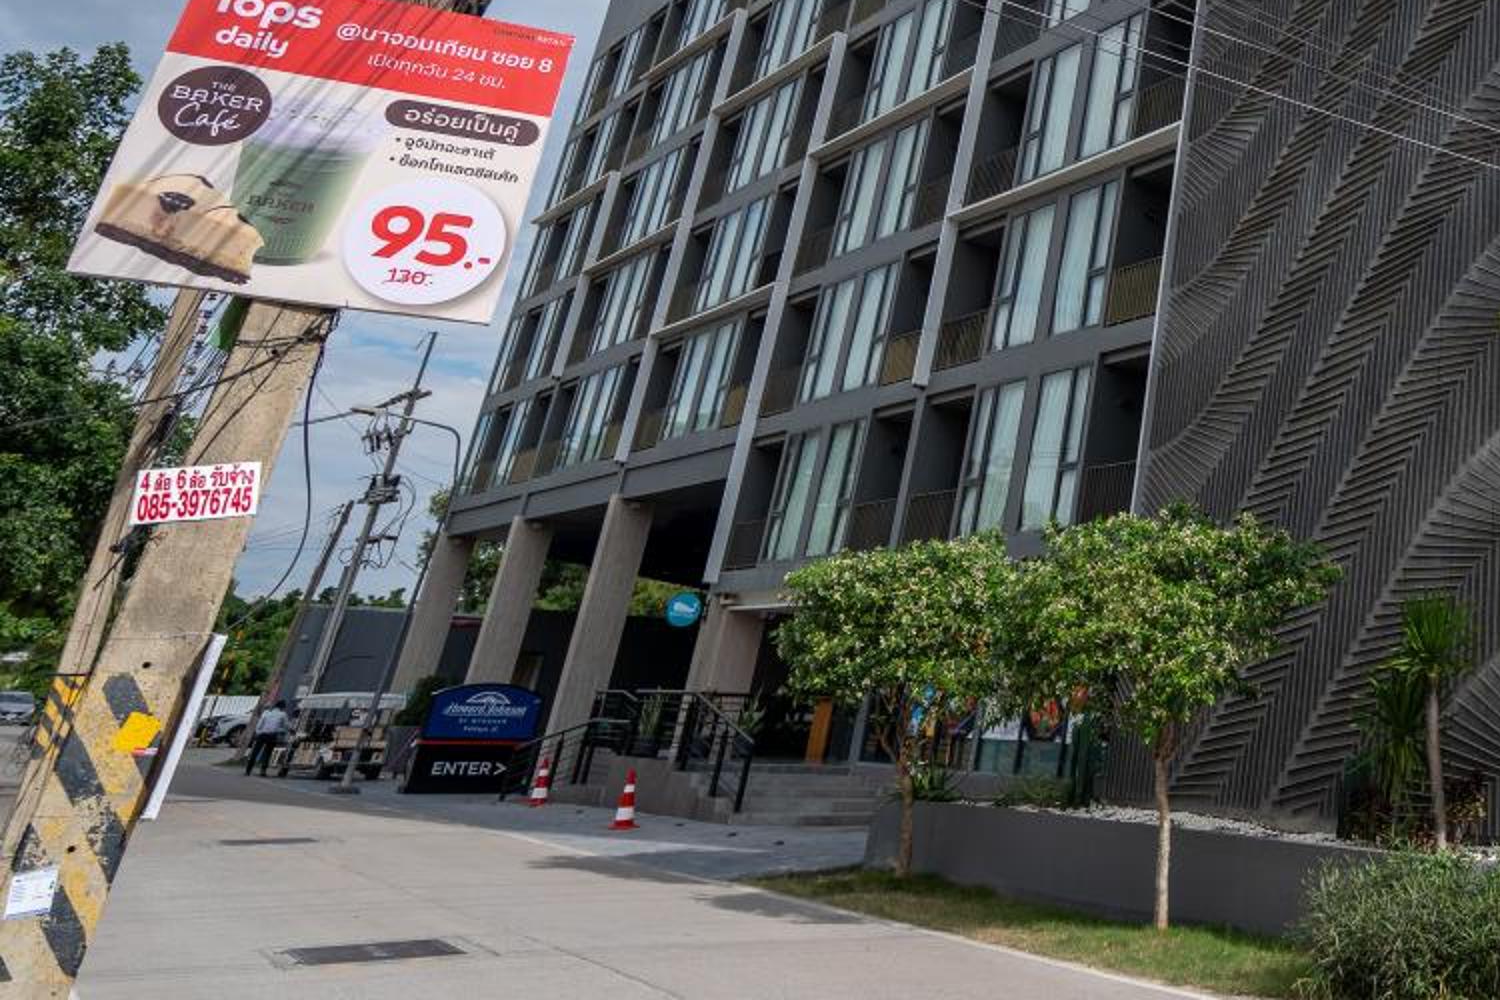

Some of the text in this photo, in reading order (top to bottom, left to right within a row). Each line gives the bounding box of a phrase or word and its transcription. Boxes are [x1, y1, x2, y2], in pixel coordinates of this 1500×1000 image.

[215, 24, 289, 59] daily
[336, 22, 487, 63] @นาจอมเทียน
[491, 50, 536, 70] ซอย
[538, 58, 554, 74] 8
[211, 81, 238, 92] THE
[367, 52, 506, 90] เปิดทุกวัน 24 ชม.
[172, 84, 264, 112] BAKER
[174, 101, 242, 137] Café
[404, 106, 522, 143] อร่อยเป็นคู่
[371, 205, 491, 267] 95.-
[141, 471, 151, 492] 4
[176, 469, 187, 489] 6
[210, 464, 255, 487] รับจ้าง
[137, 486, 253, 521] 085-3976745
[431, 761, 492, 776] ENTER
